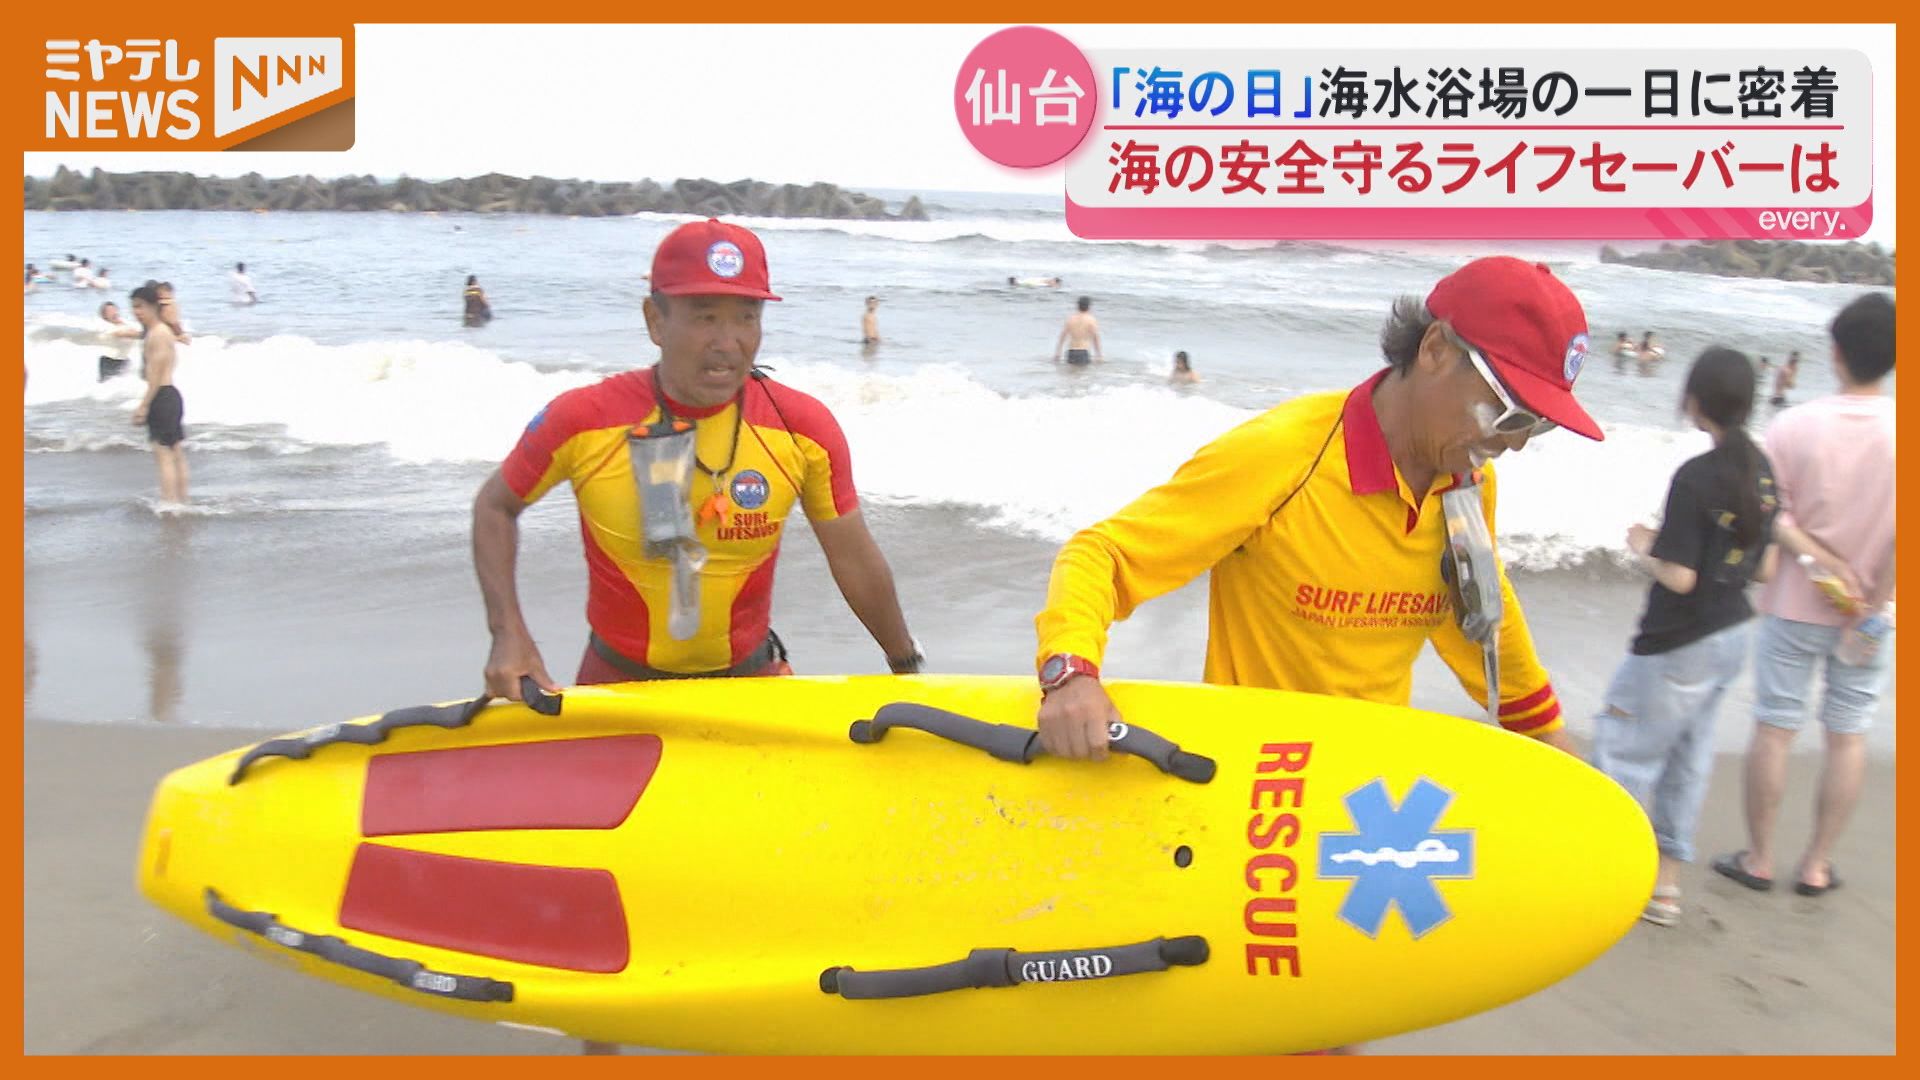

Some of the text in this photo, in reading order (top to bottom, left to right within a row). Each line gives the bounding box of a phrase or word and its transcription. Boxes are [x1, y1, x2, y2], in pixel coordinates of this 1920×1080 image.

[734, 512, 768, 526] SURF
[1295, 583, 1364, 614] SURF
[1243, 741, 1314, 978] RESCUE
[1022, 954, 1113, 983] GUARD
